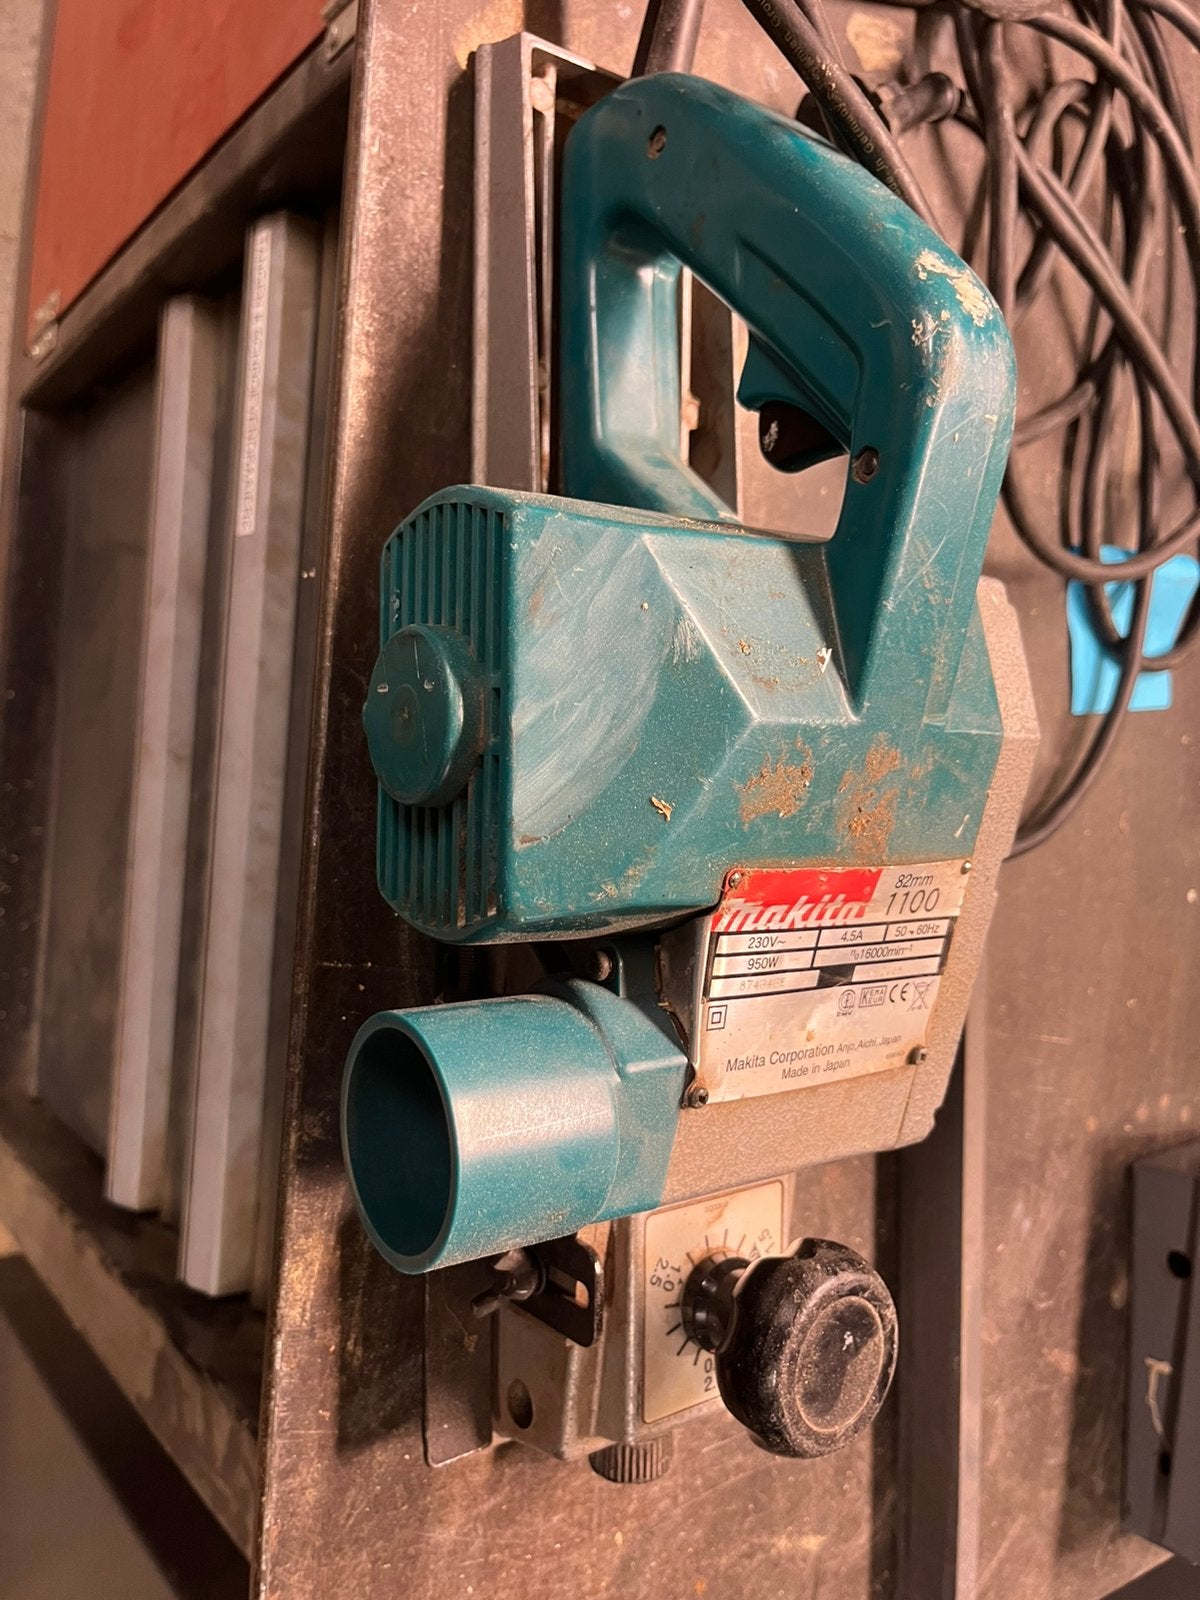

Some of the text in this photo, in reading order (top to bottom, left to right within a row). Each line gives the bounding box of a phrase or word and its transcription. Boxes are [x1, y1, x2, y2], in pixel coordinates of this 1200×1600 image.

[895, 873, 933, 889] 82mm
[885, 888, 940, 916] 1100
[841, 930, 863, 942] 4.5A
[747, 957, 779, 970] 950W
[726, 1055, 765, 1072] Makita
[769, 1043, 834, 1065] Corporation
[782, 1058, 850, 1080] Made in Japan
[650, 1256, 669, 1289] 2.5
[663, 1265, 681, 1292] 1.0
